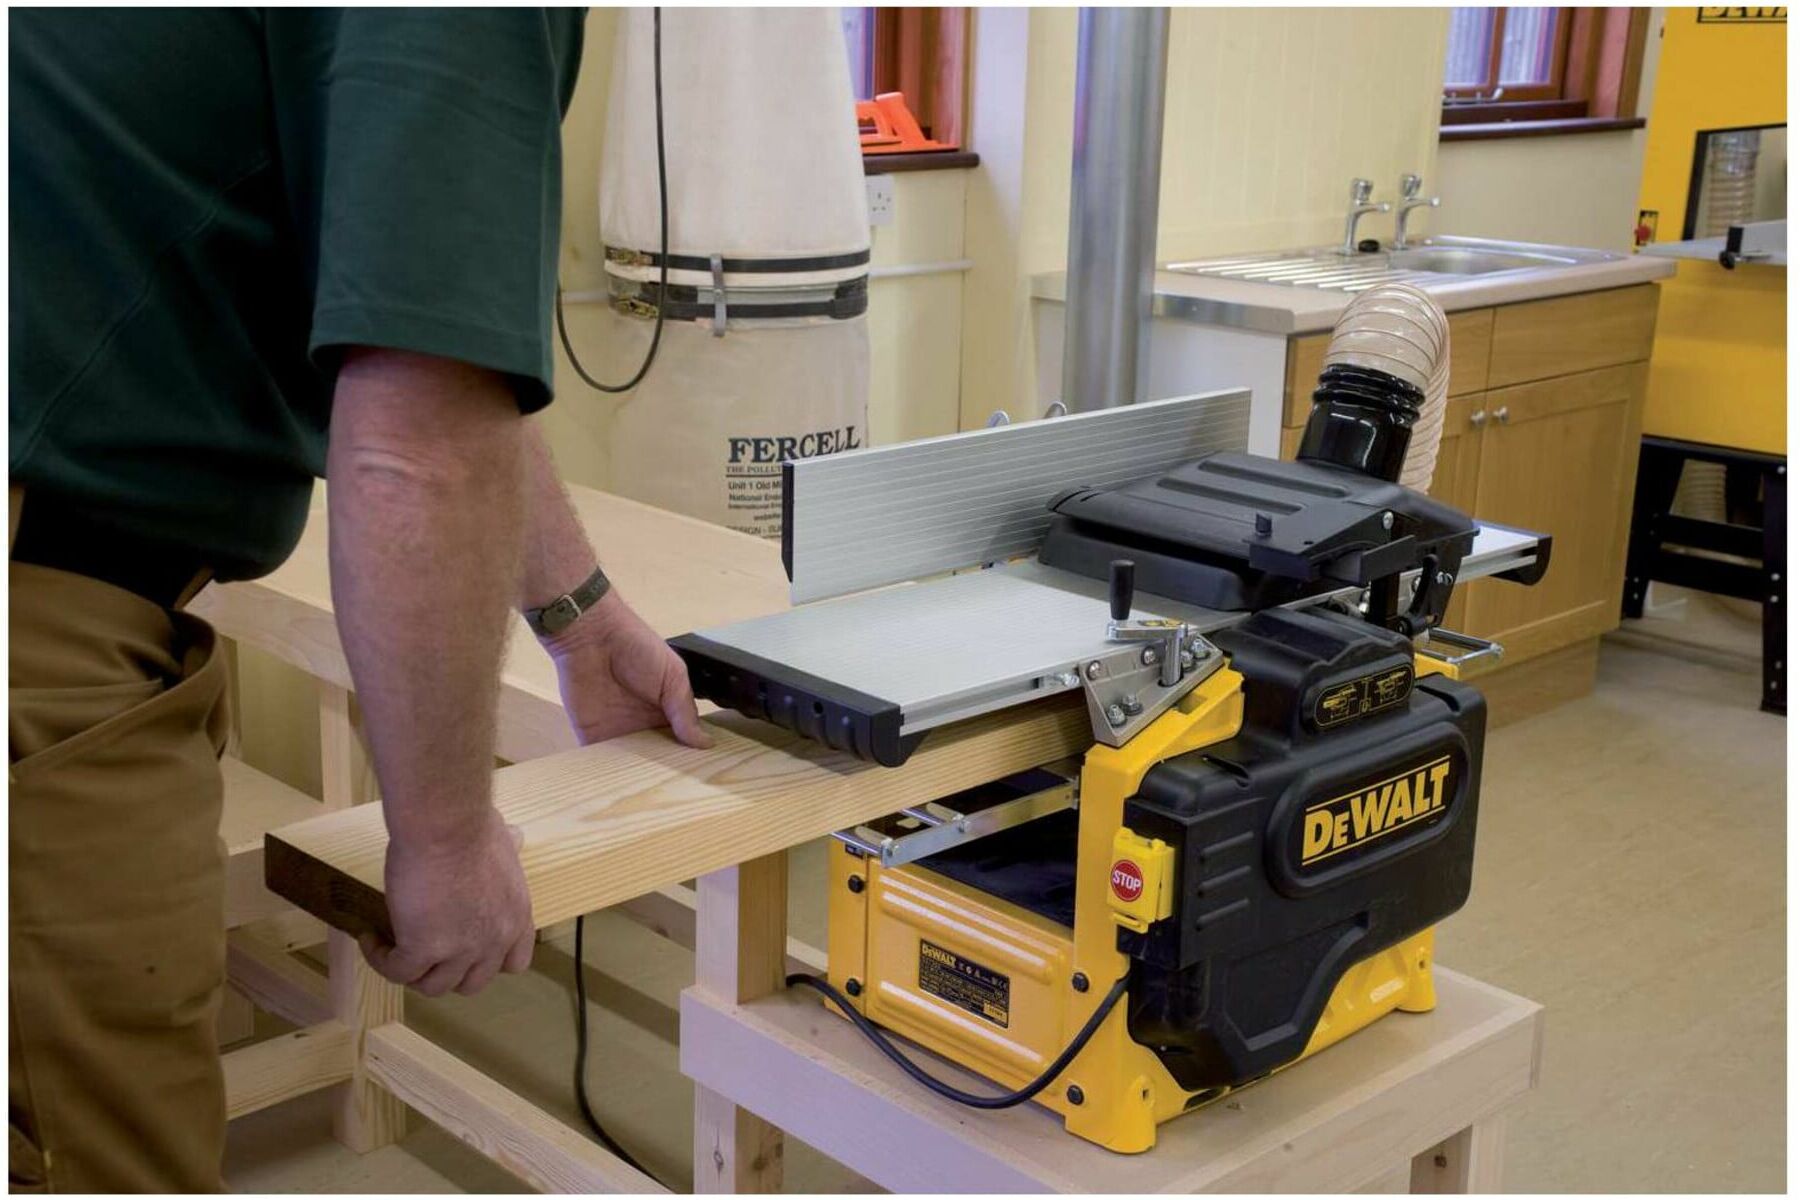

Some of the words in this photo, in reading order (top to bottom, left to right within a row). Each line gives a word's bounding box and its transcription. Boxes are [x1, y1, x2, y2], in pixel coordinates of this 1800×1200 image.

[728, 426, 861, 462] FERCELL
[728, 481, 746, 490] Unit
[756, 481, 771, 490] Old
[1302, 761, 1450, 860] DEWALT
[1112, 869, 1142, 892] STOP
